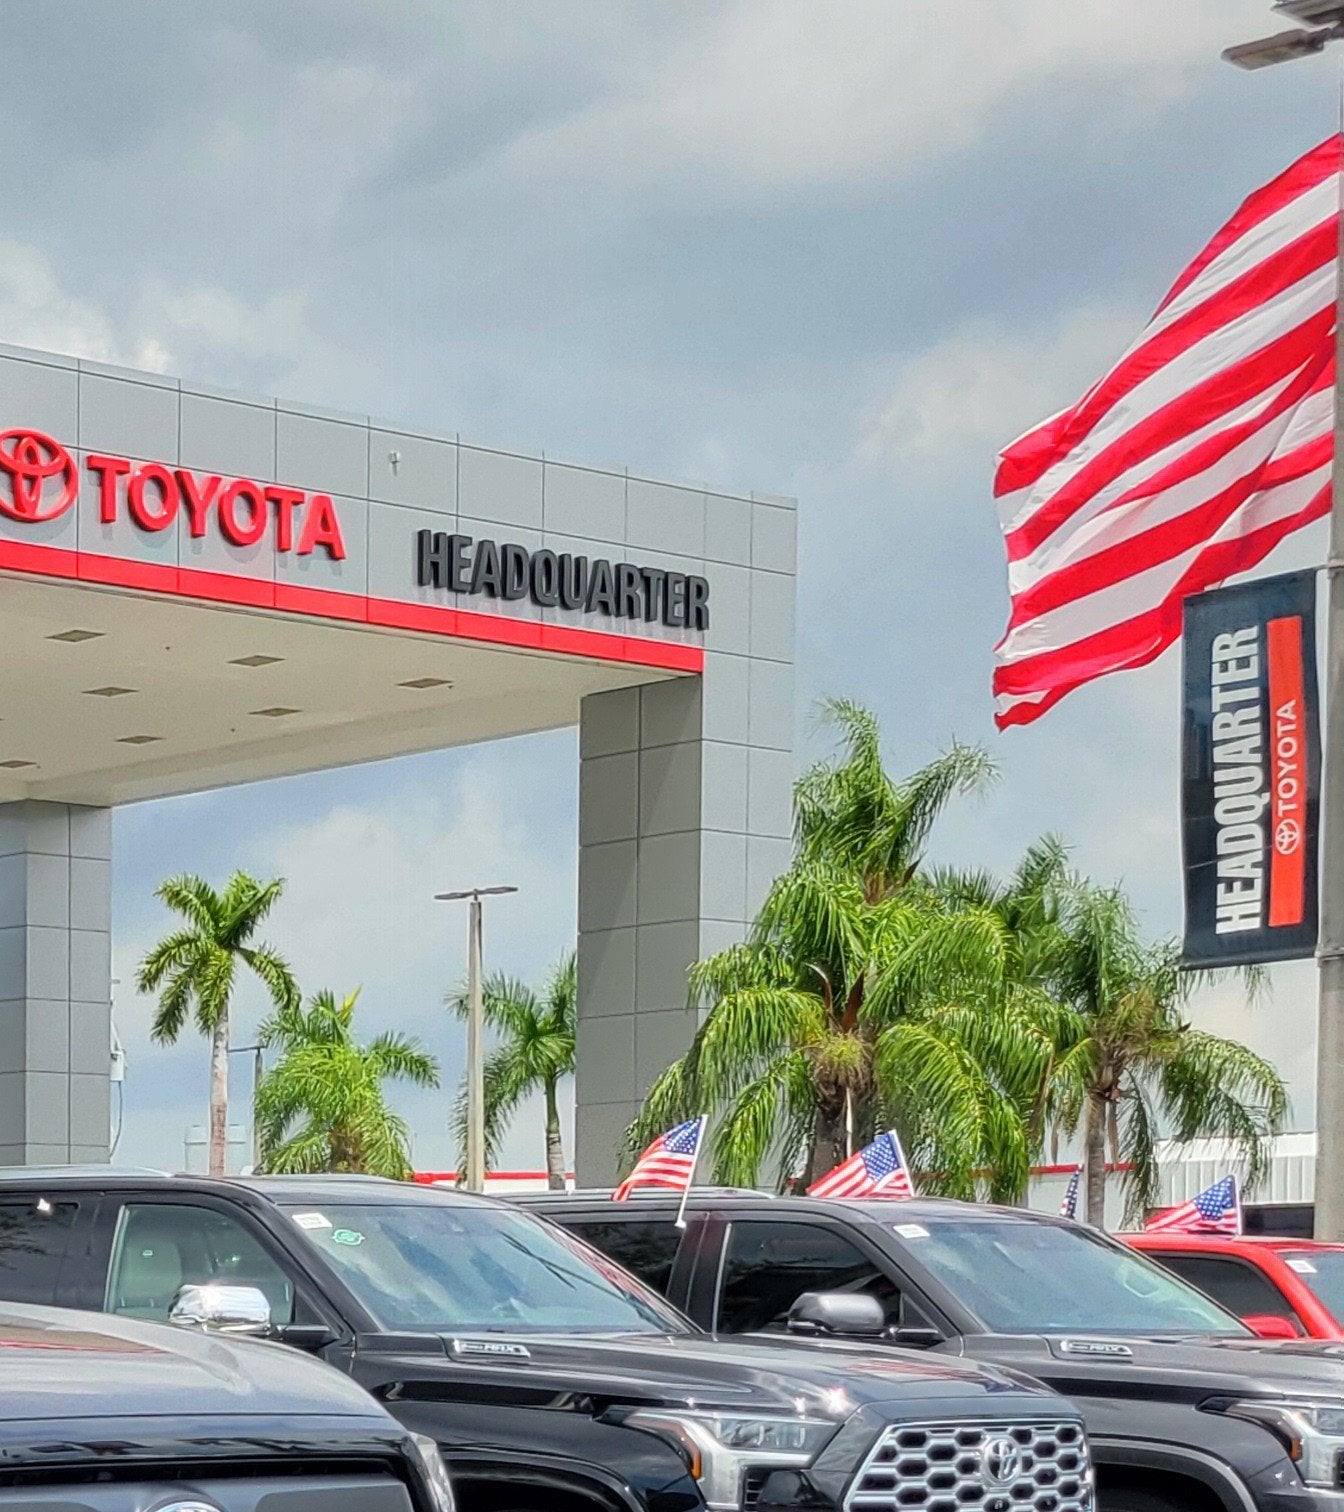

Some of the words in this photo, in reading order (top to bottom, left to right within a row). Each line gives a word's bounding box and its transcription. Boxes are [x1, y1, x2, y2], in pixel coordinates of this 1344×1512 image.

[86, 454, 347, 560] TOYOTA
[417, 529, 710, 631] HEADQUARTER
[1211, 623, 1271, 935] HEADQUARTER
[1276, 699, 1299, 817] TOYOTA
